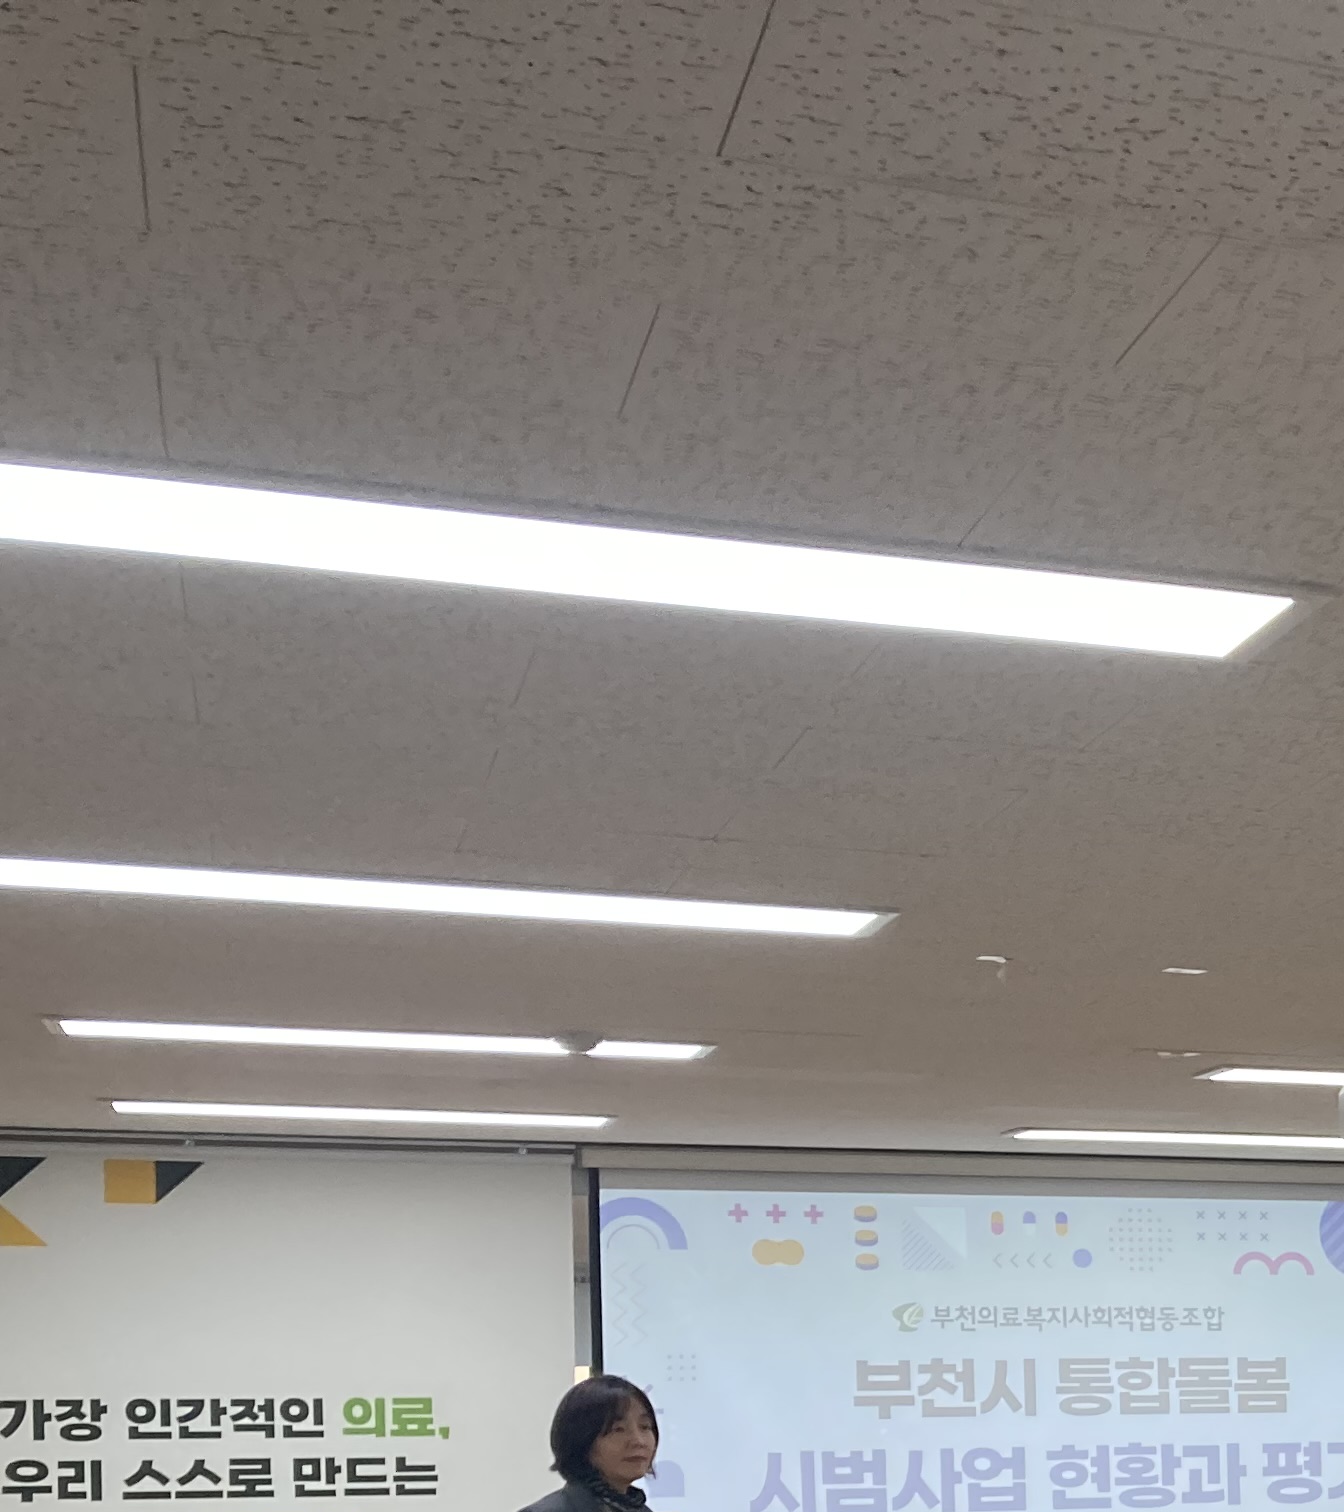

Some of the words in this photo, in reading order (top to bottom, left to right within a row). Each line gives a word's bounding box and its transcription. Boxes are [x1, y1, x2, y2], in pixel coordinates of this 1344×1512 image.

[930, 1304, 1225, 1333] 부천의료복지사회적협동조합
[853, 1357, 1038, 1420] 부천시
[1055, 1356, 1291, 1417] 통합돌봄
[0, 1397, 108, 1441] 가장
[124, 1396, 326, 1440] 인간적인
[341, 1396, 451, 1440] 의료,
[1, 1459, 103, 1503] 우리
[121, 1457, 276, 1501] 스스로
[292, 1456, 440, 1499] 만드는
[1045, 1442, 1248, 1511] 현황과
